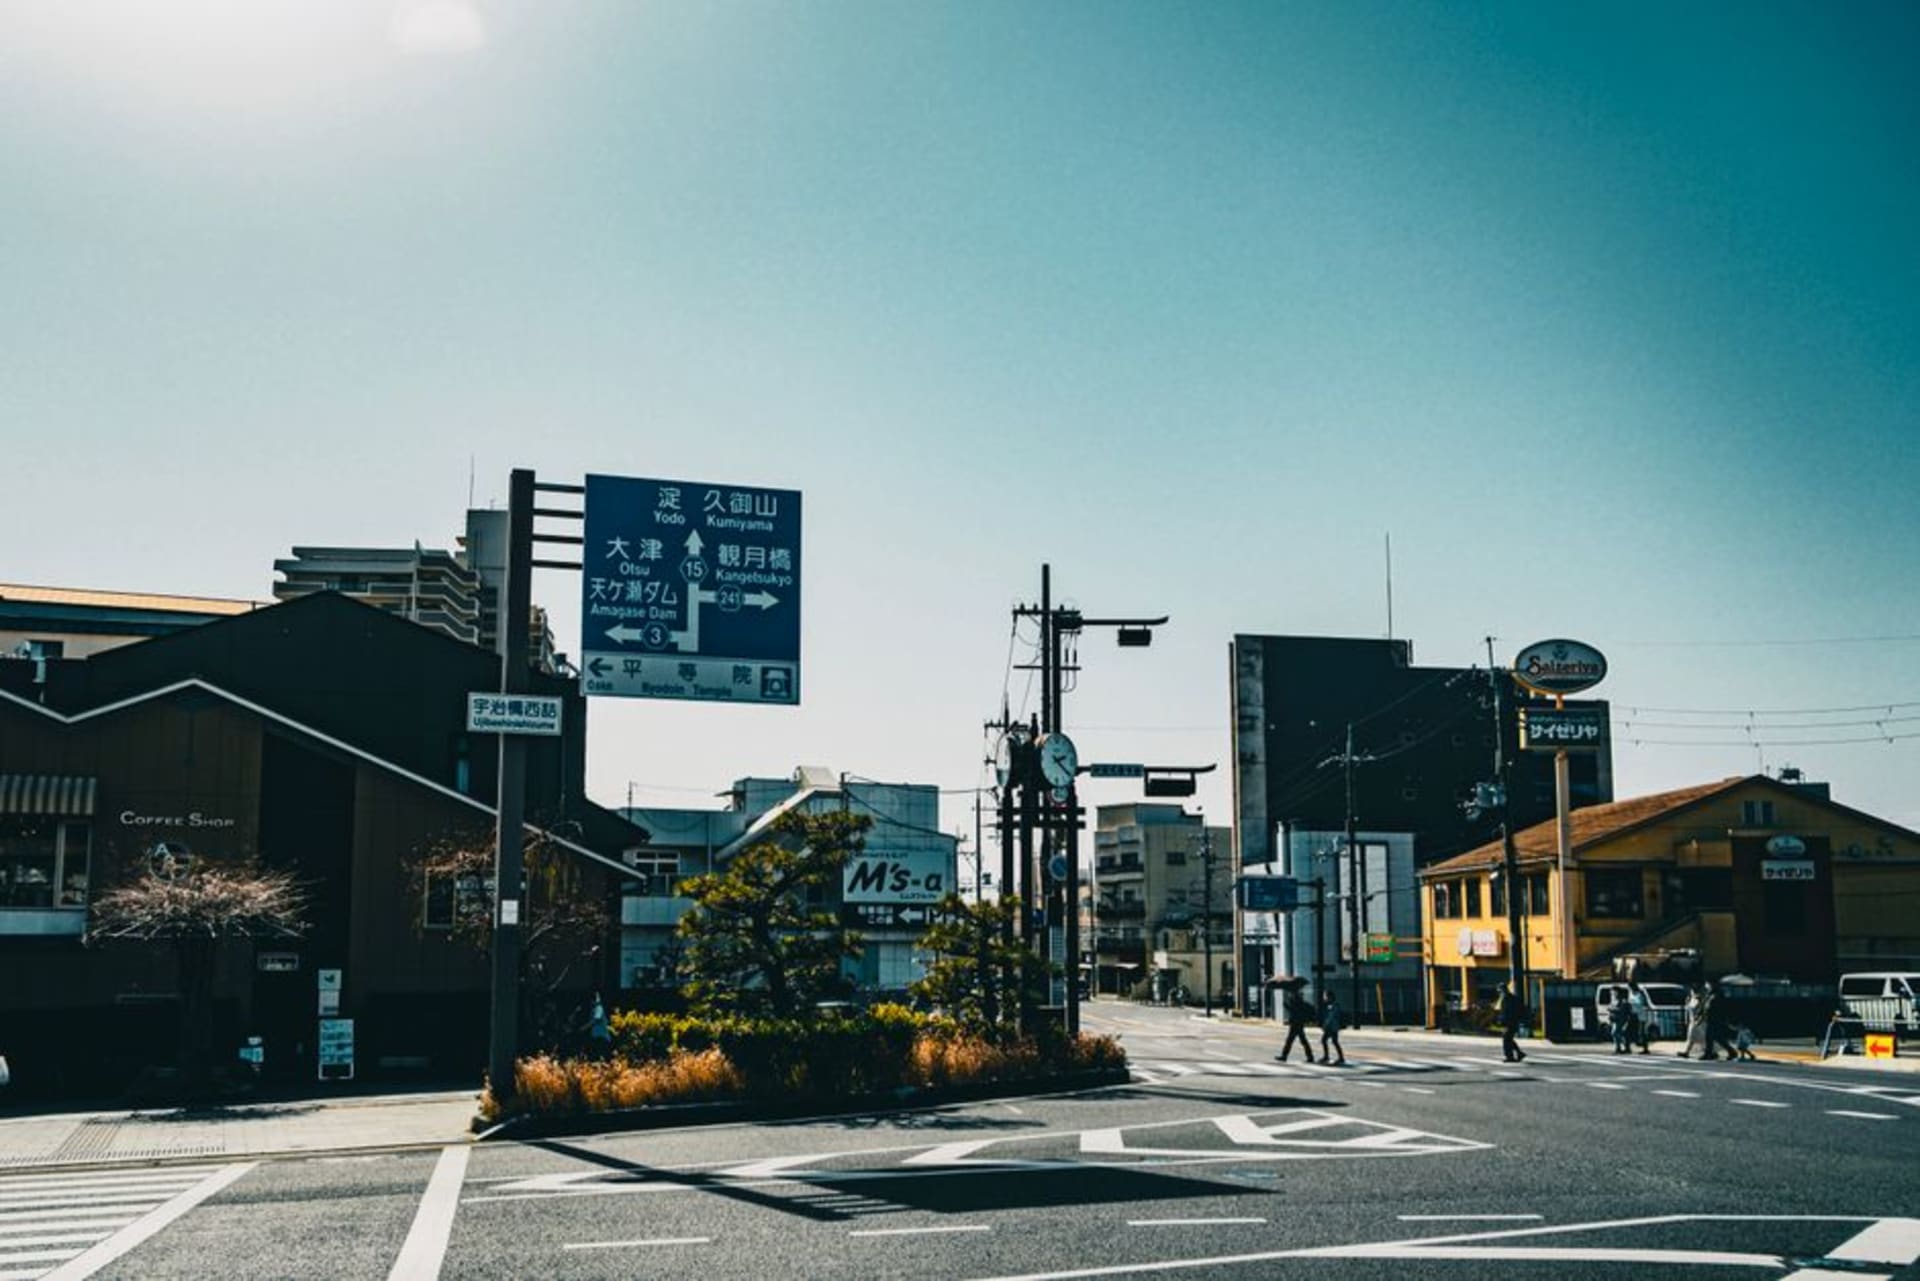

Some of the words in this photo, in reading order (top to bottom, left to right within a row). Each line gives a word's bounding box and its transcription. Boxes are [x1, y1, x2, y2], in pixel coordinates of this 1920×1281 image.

[658, 487, 682, 509] 淀
[703, 490, 777, 517] 久御山
[653, 511, 686, 525] Yodo
[706, 516, 774, 532] Kumiyama
[605, 537, 664, 561] 大津
[718, 543, 791, 571] 観月橋
[619, 562, 650, 576] Otsu
[685, 562, 703, 577] 15
[715, 569, 792, 587] Kangetsukyo
[719, 592, 740, 605] 241
[590, 602, 646, 618] Amagase
[649, 607, 677, 620] Dam
[650, 629, 661, 643] 3
[1530, 722, 1599, 740] サイゼリヤ
